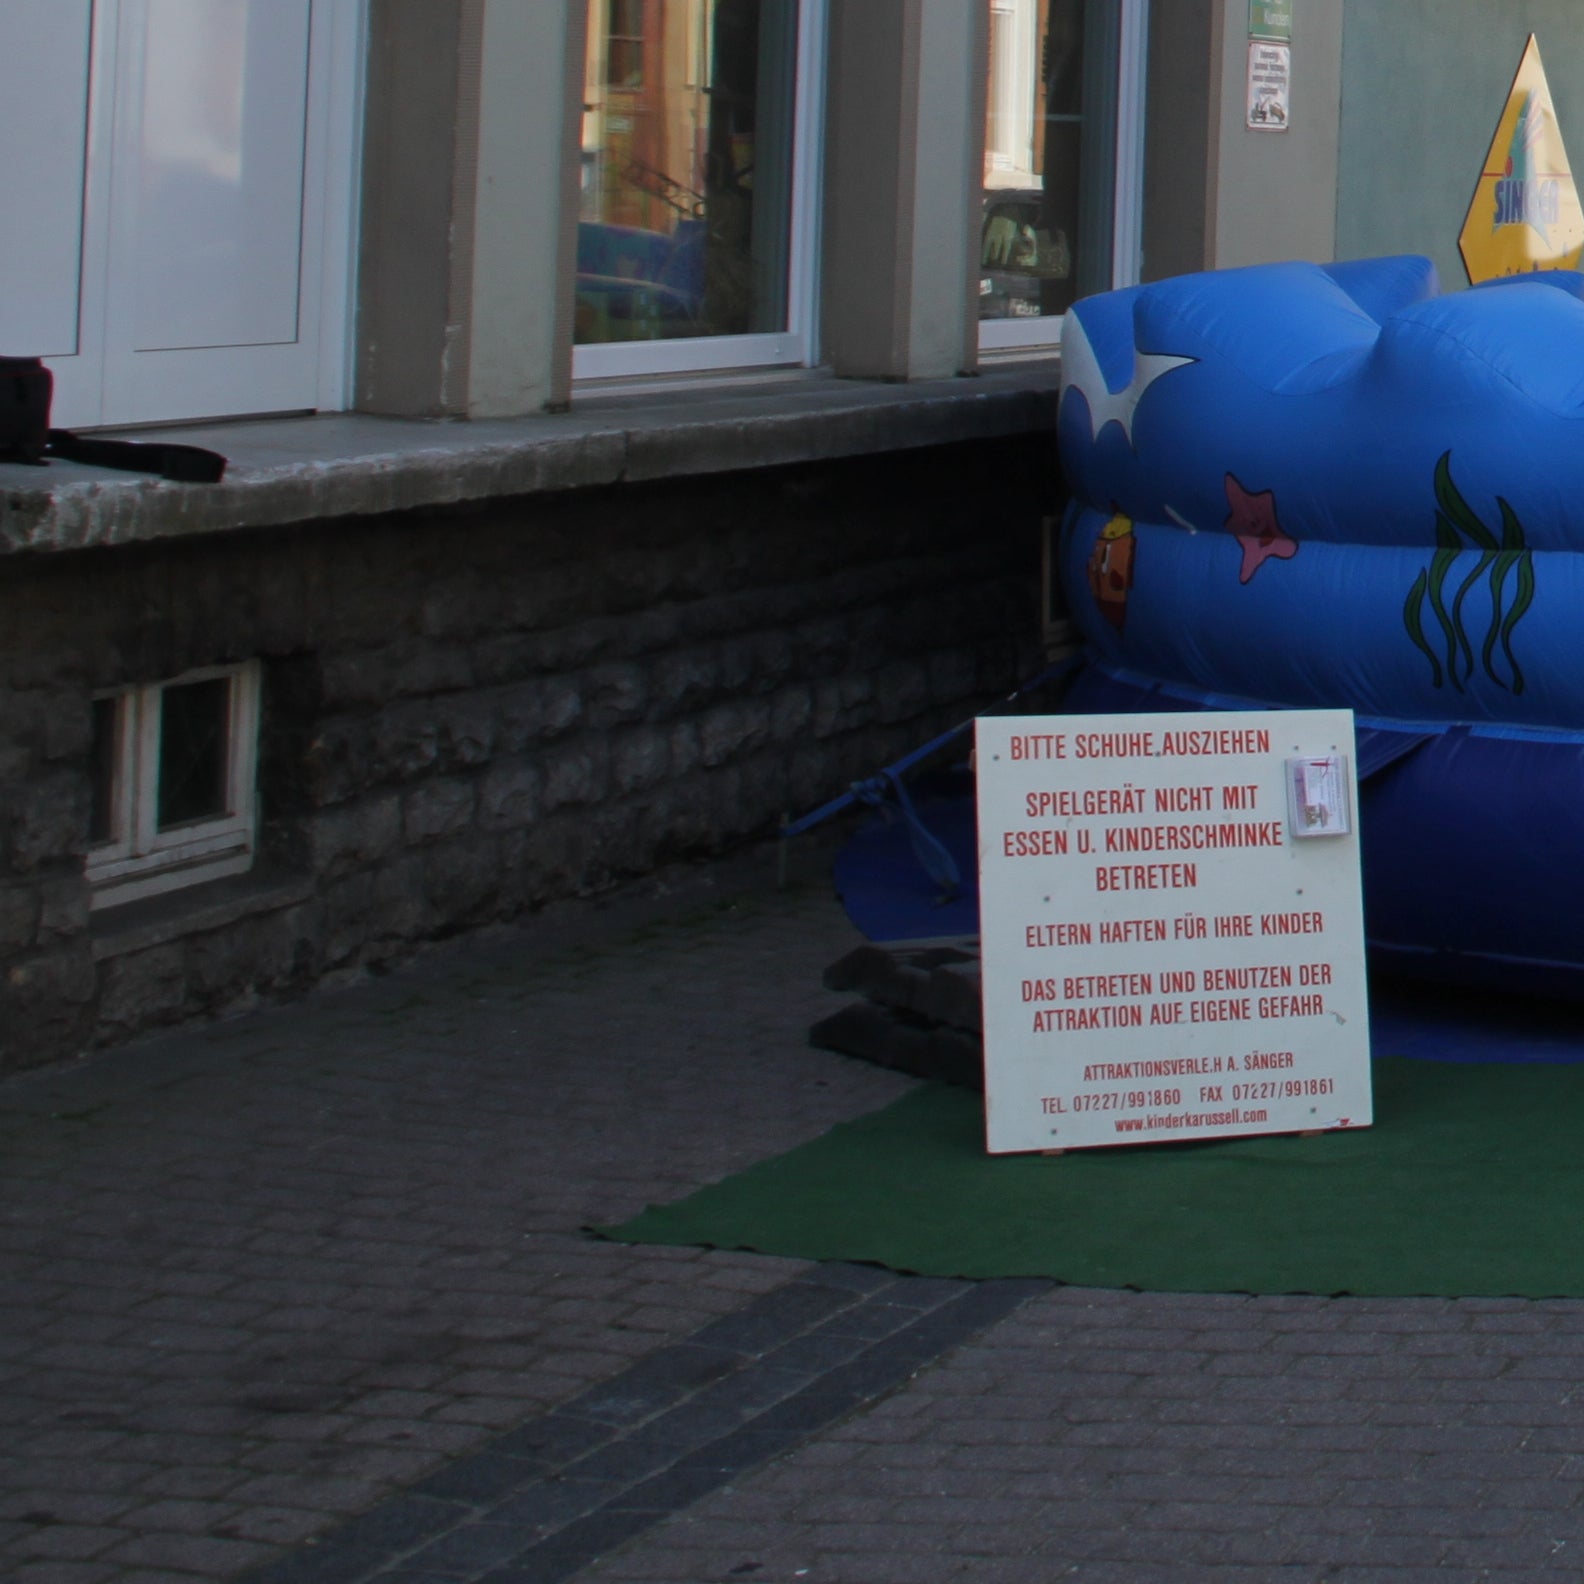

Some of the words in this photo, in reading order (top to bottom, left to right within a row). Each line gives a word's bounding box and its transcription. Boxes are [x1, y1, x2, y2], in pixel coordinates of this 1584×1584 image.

[1011, 735, 1067, 760] BITTE
[1076, 732, 1153, 758] SCHUHE
[1161, 729, 1270, 755] AUSZIEHEN
[1026, 783, 1146, 817] SPIELGERÄT
[1155, 786, 1214, 811] NICHT
[1222, 784, 1258, 810] MIT
[1004, 831, 1069, 856] ESSEN
[1077, 830, 1096, 854] U.
[1106, 822, 1282, 851] KINDERSCHMINKE
[1096, 863, 1197, 891] BETRETEN
[1027, 923, 1092, 947] ELTERN
[1100, 920, 1167, 942] HAFTEN
[1174, 912, 1208, 939] FÜR
[1215, 915, 1253, 936] IHRE
[1261, 912, 1323, 934] KINDER
[1023, 978, 1056, 1002] DAS
[1064, 974, 1153, 999] BETRETEN
[1161, 971, 1196, 993] UND
[1203, 966, 1293, 991] BENUTZEN
[1300, 964, 1332, 985] DER
[1034, 1005, 1143, 1030] ATTRAKTION
[1150, 1003, 1184, 1024] AUF
[1191, 999, 1250, 1022] EIGENE
[1259, 994, 1323, 1018] GEFAHR
[1084, 1056, 1223, 1080] ATTRAKTIONSVERLEH
[1228, 1056, 1240, 1072] A.
[1244, 1050, 1295, 1071] SÄNGER
[1073, 1089, 1182, 1111] 07227/991860
[1200, 1085, 1223, 1103] FAX
[1233, 1078, 1334, 1100] 07227/991861
[1114, 1108, 1269, 1132] www.kinderkarussell.com
